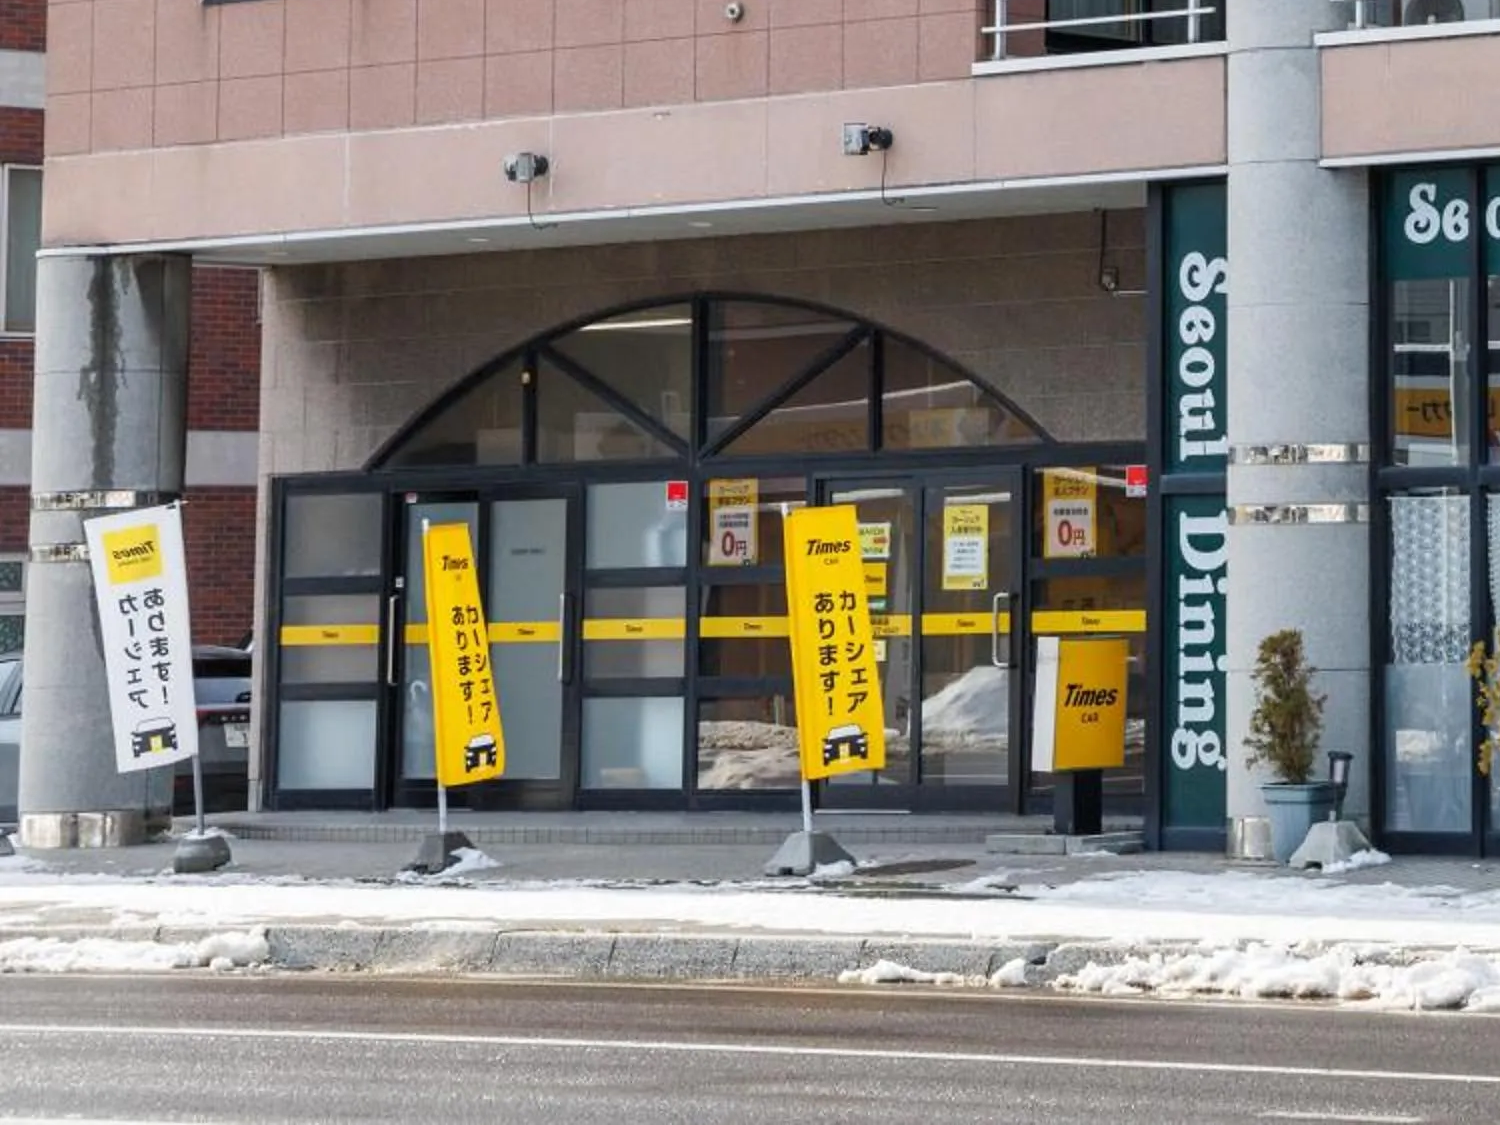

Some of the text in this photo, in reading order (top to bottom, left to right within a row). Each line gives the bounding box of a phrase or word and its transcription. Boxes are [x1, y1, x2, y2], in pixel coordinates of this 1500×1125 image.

[721, 530, 747, 557] 0円
[806, 538, 852, 556] Times
[1057, 520, 1085, 547] 0円
[1171, 251, 1228, 771] Seoul Dining
[466, 605, 493, 722] カーシェア
[814, 593, 840, 716] あります！
[839, 590, 868, 714] カーシェア
[1064, 682, 1118, 707] Times
